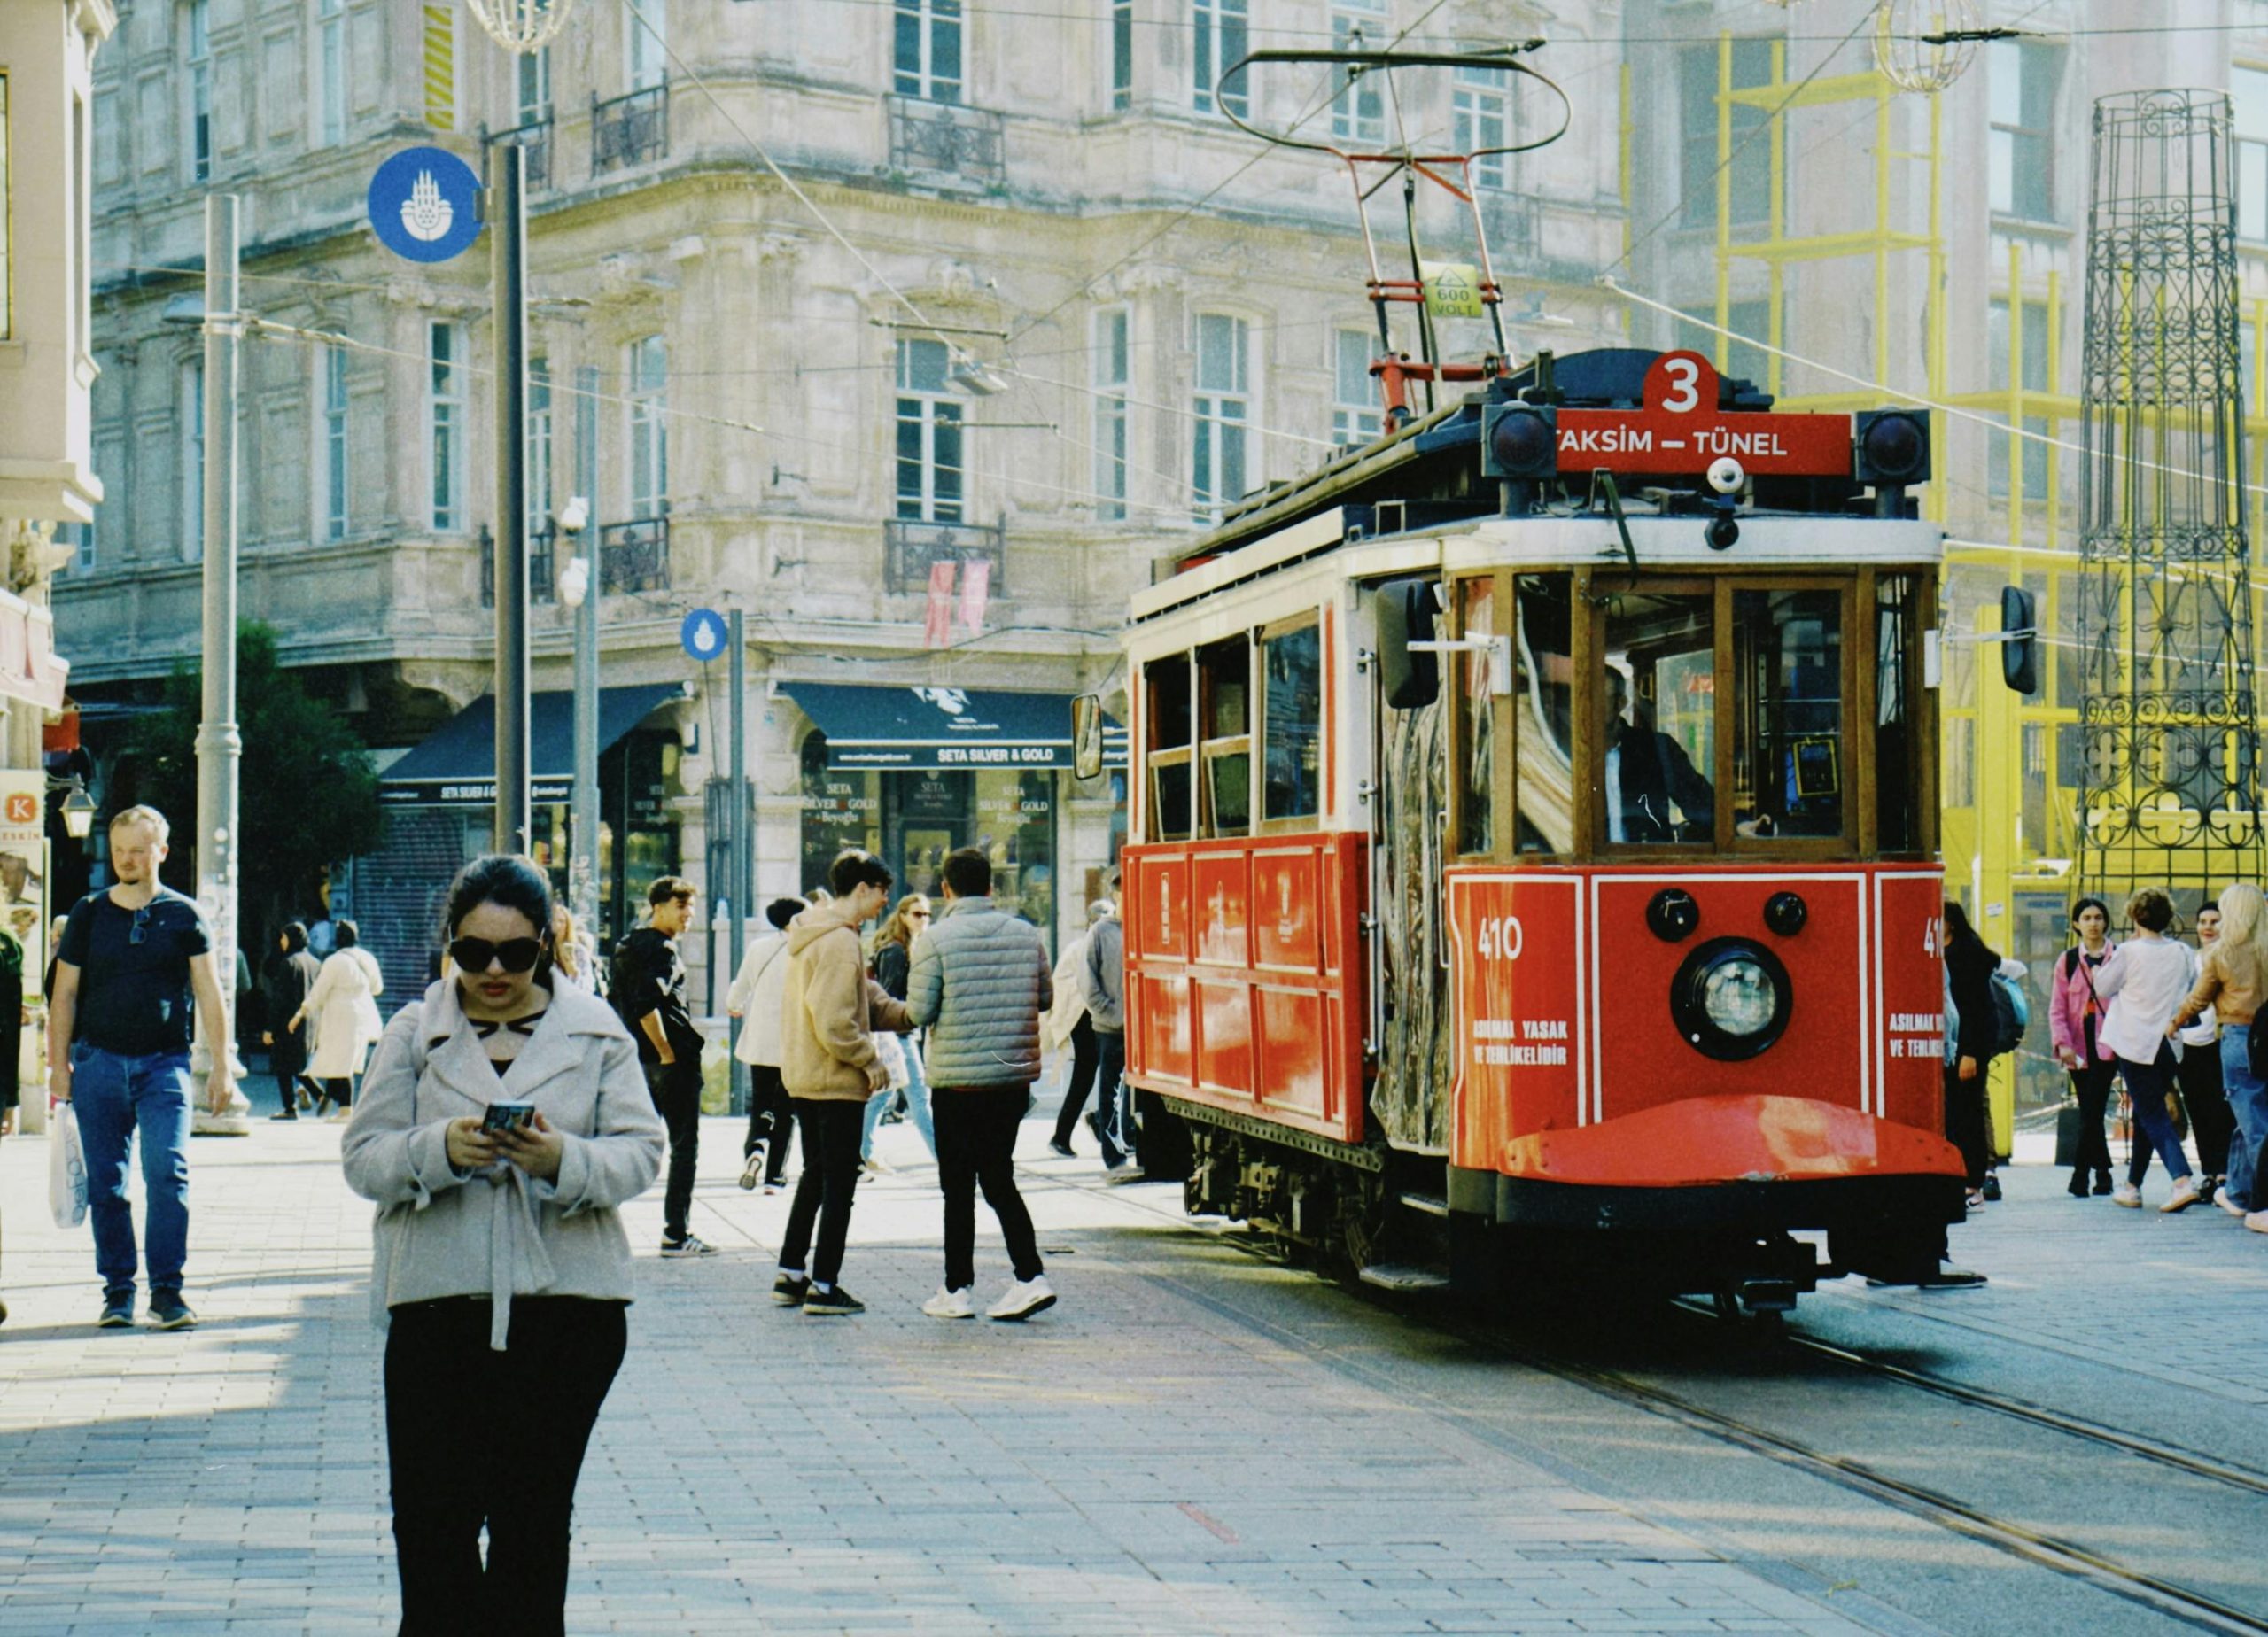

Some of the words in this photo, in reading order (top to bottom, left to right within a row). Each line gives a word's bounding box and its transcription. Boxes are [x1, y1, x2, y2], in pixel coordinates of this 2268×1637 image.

[1437, 288, 1470, 301] 600
[1435, 304, 1473, 315] VOLT
[1661, 358, 1699, 413] 3
[1556, 423, 1652, 453] AKSİM
[1692, 426, 1788, 456] TÜNEL
[937, 749, 968, 762] SETA
[969, 749, 1009, 762] SILVER
[1012, 749, 1020, 761] &
[1021, 748, 1054, 762] GOLD
[827, 783, 853, 795] SETA
[12, 798, 31, 818] K
[848, 797, 877, 810] GOLD
[1021, 801, 1049, 811] GOLD
[1478, 916, 1523, 960] 410
[1923, 916, 1945, 959] 41
[1522, 1020, 1568, 1039] YASAK
[1889, 1012, 1935, 1032] ASILMAK
[1485, 1043, 1567, 1066] TEHLİKELİDİR
[1890, 1038, 1904, 1058] VE
